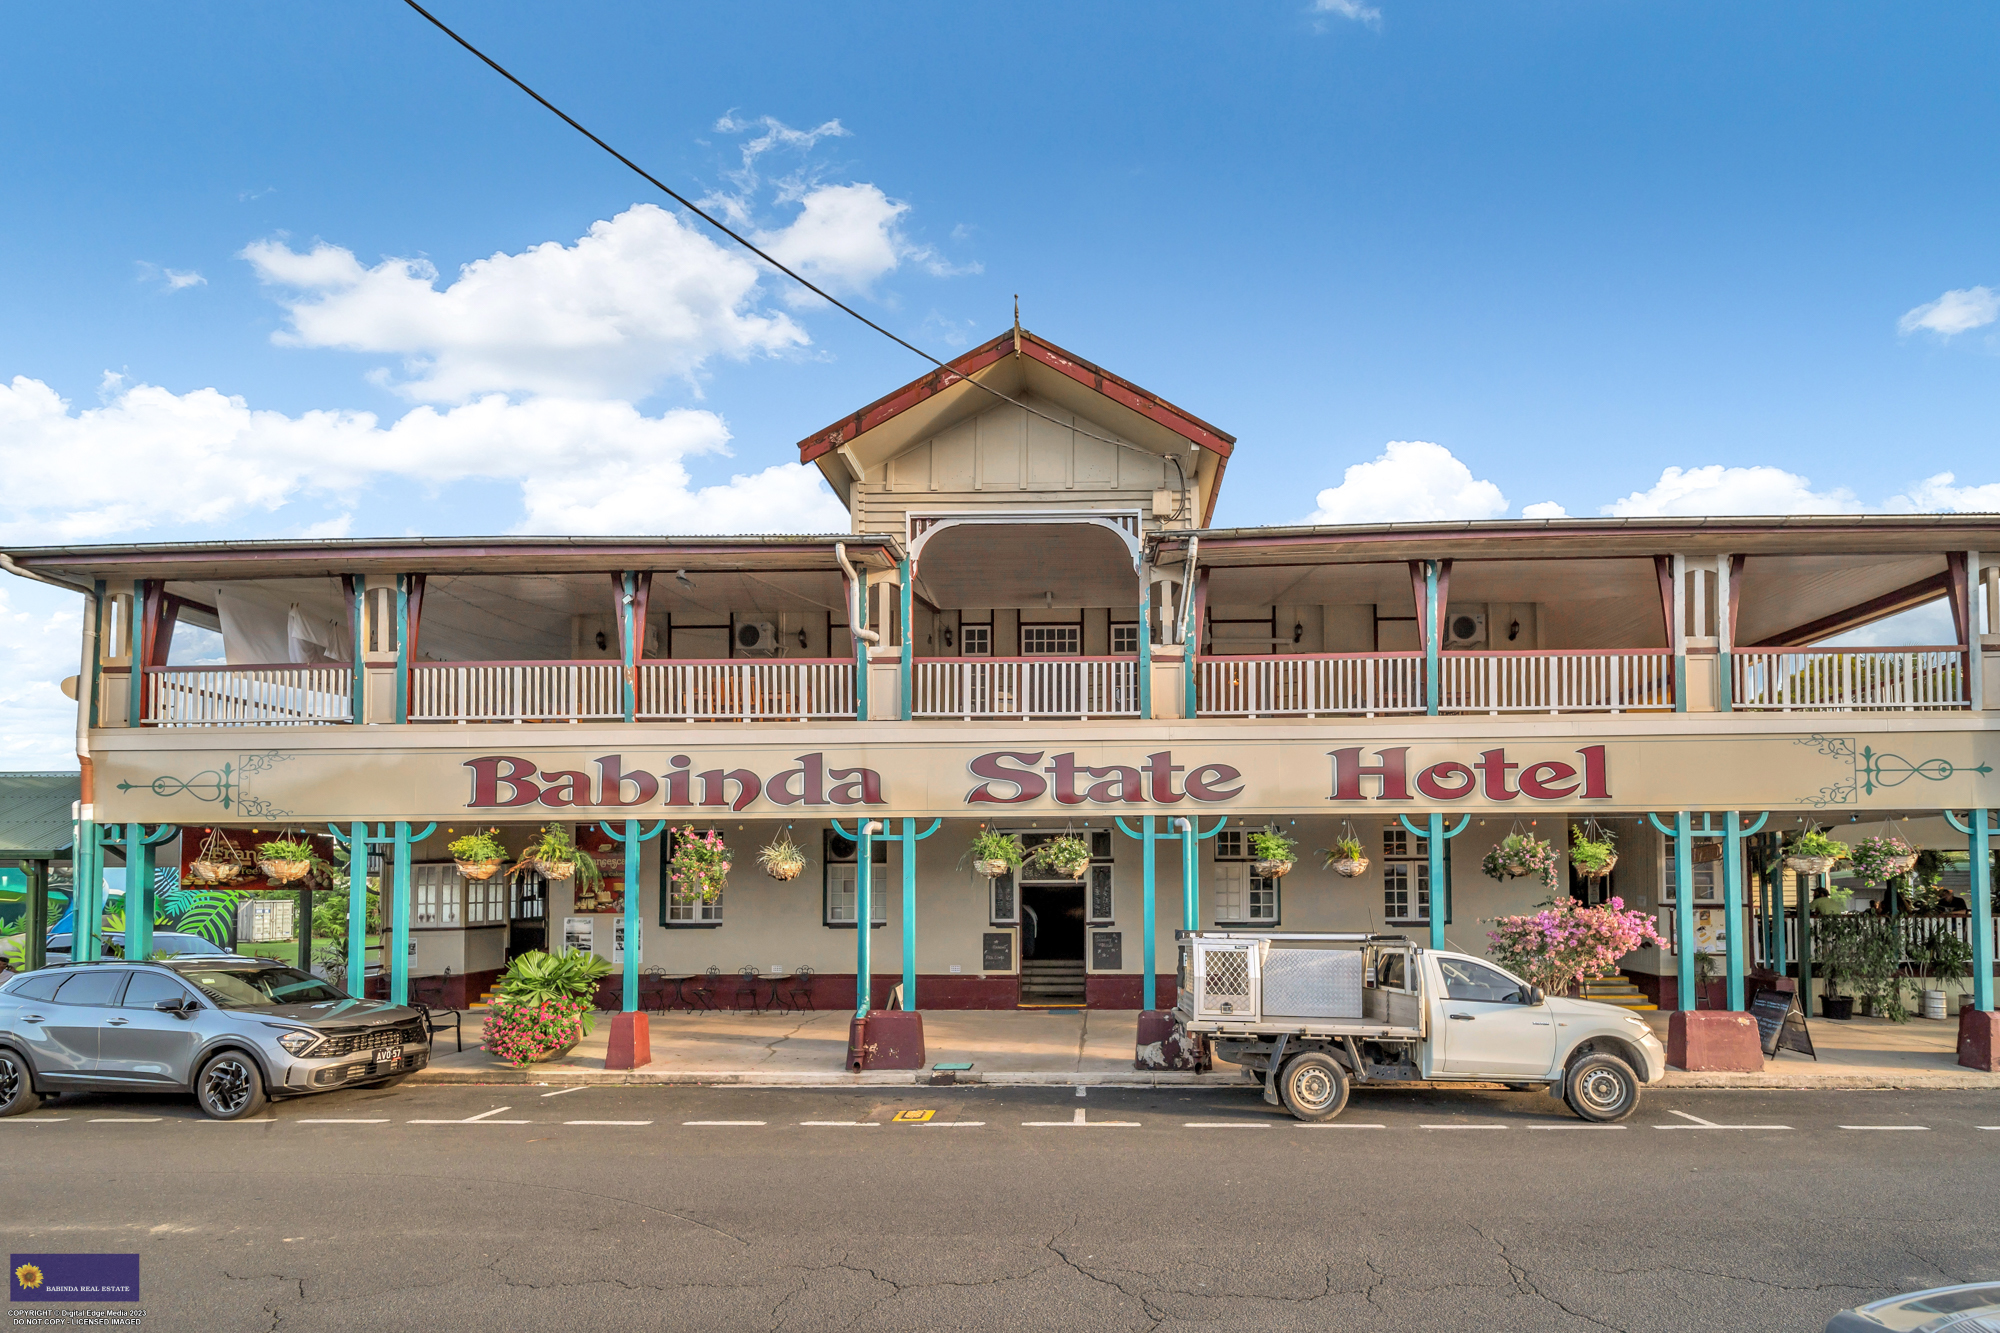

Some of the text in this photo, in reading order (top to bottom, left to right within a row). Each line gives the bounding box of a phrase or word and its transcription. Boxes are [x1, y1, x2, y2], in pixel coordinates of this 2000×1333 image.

[462, 745, 1613, 812] Babinda State Hotel
